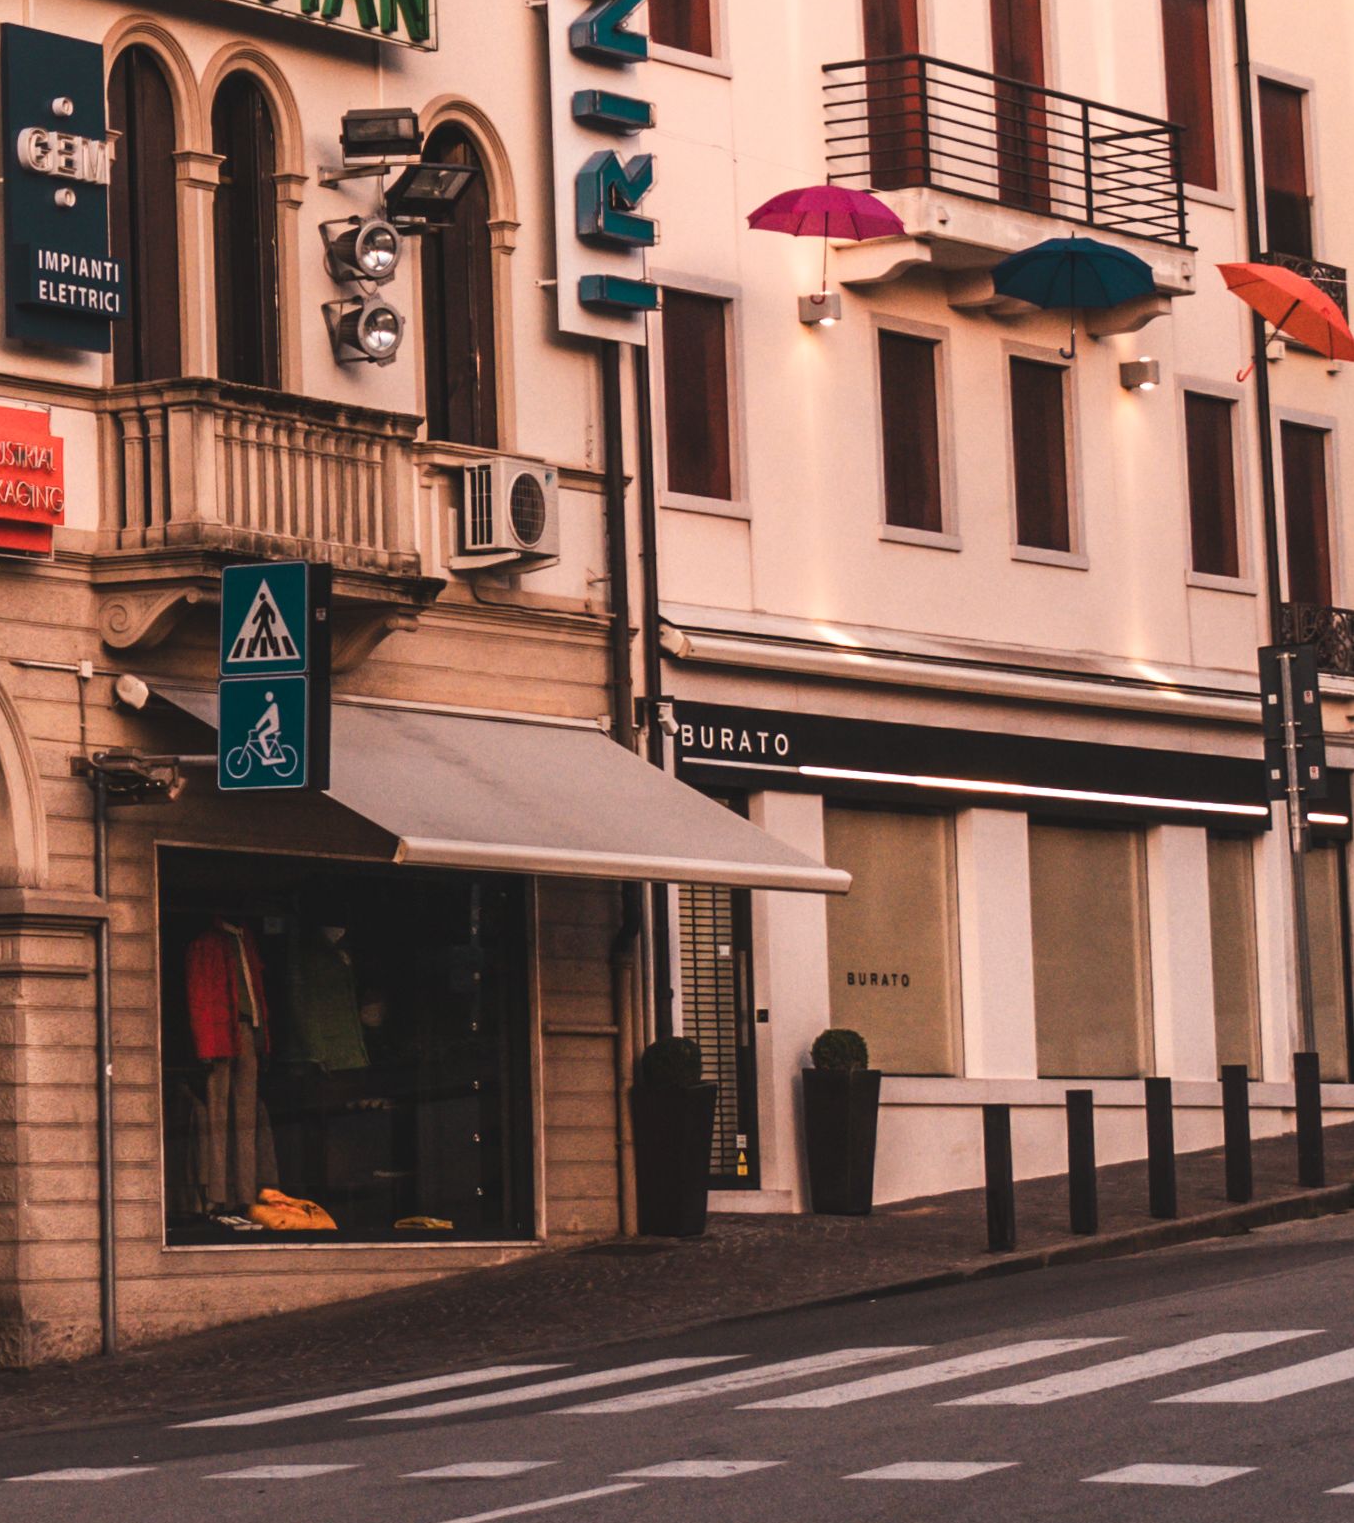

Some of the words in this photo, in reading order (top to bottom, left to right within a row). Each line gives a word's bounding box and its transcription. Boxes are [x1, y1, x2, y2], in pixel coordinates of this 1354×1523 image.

[18, 127, 111, 186] GEM
[38, 249, 120, 284] IMPIANTI
[38, 279, 121, 314] ELETTRICI
[680, 723, 790, 757] BURATO
[847, 971, 912, 988] BURATO
